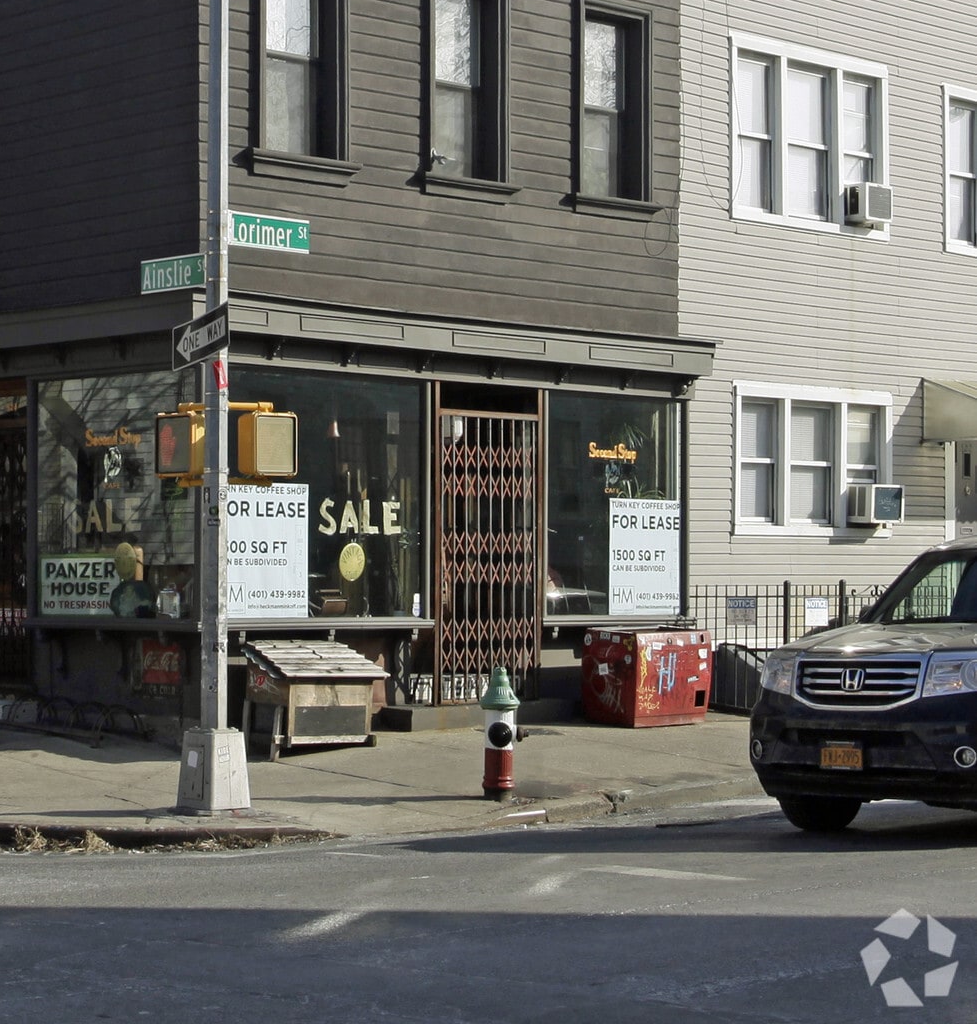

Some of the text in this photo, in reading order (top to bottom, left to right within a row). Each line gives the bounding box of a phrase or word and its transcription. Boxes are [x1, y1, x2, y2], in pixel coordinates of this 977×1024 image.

[232, 213, 308, 249] Lorimer St
[142, 260, 192, 291] Ainslie
[183, 319, 223, 353] ONE WAY
[588, 441, 637, 464] Second Stop
[238, 486, 253, 494] KEY
[255, 486, 285, 495] COFFEE
[286, 487, 307, 495] SHOP
[227, 500, 306, 518] OR LEASE
[612, 501, 628, 509] TURN
[629, 501, 640, 509] KEY
[641, 502, 664, 510] COFFEE
[318, 497, 402, 536] SALE
[612, 514, 680, 531] FOR LEASE
[227, 540, 288, 554] 00 SQ FT
[234, 558, 243, 566] BE
[244, 558, 288, 566] SUBDIVIDED
[612, 549, 666, 562] 1500 SQ FT
[46, 561, 116, 579] PANZER
[612, 564, 666, 573] CAN BE SUBDIVIDED
[50, 581, 110, 596] HOUSE
[229, 584, 244, 603] M
[248, 590, 306, 600] (401) 439-9982
[612, 587, 633, 604] HM
[636, 592, 651, 601] (401)
[728, 599, 755, 607] NOTICE
[43, 600, 112, 610] NO TRESPASSIN
